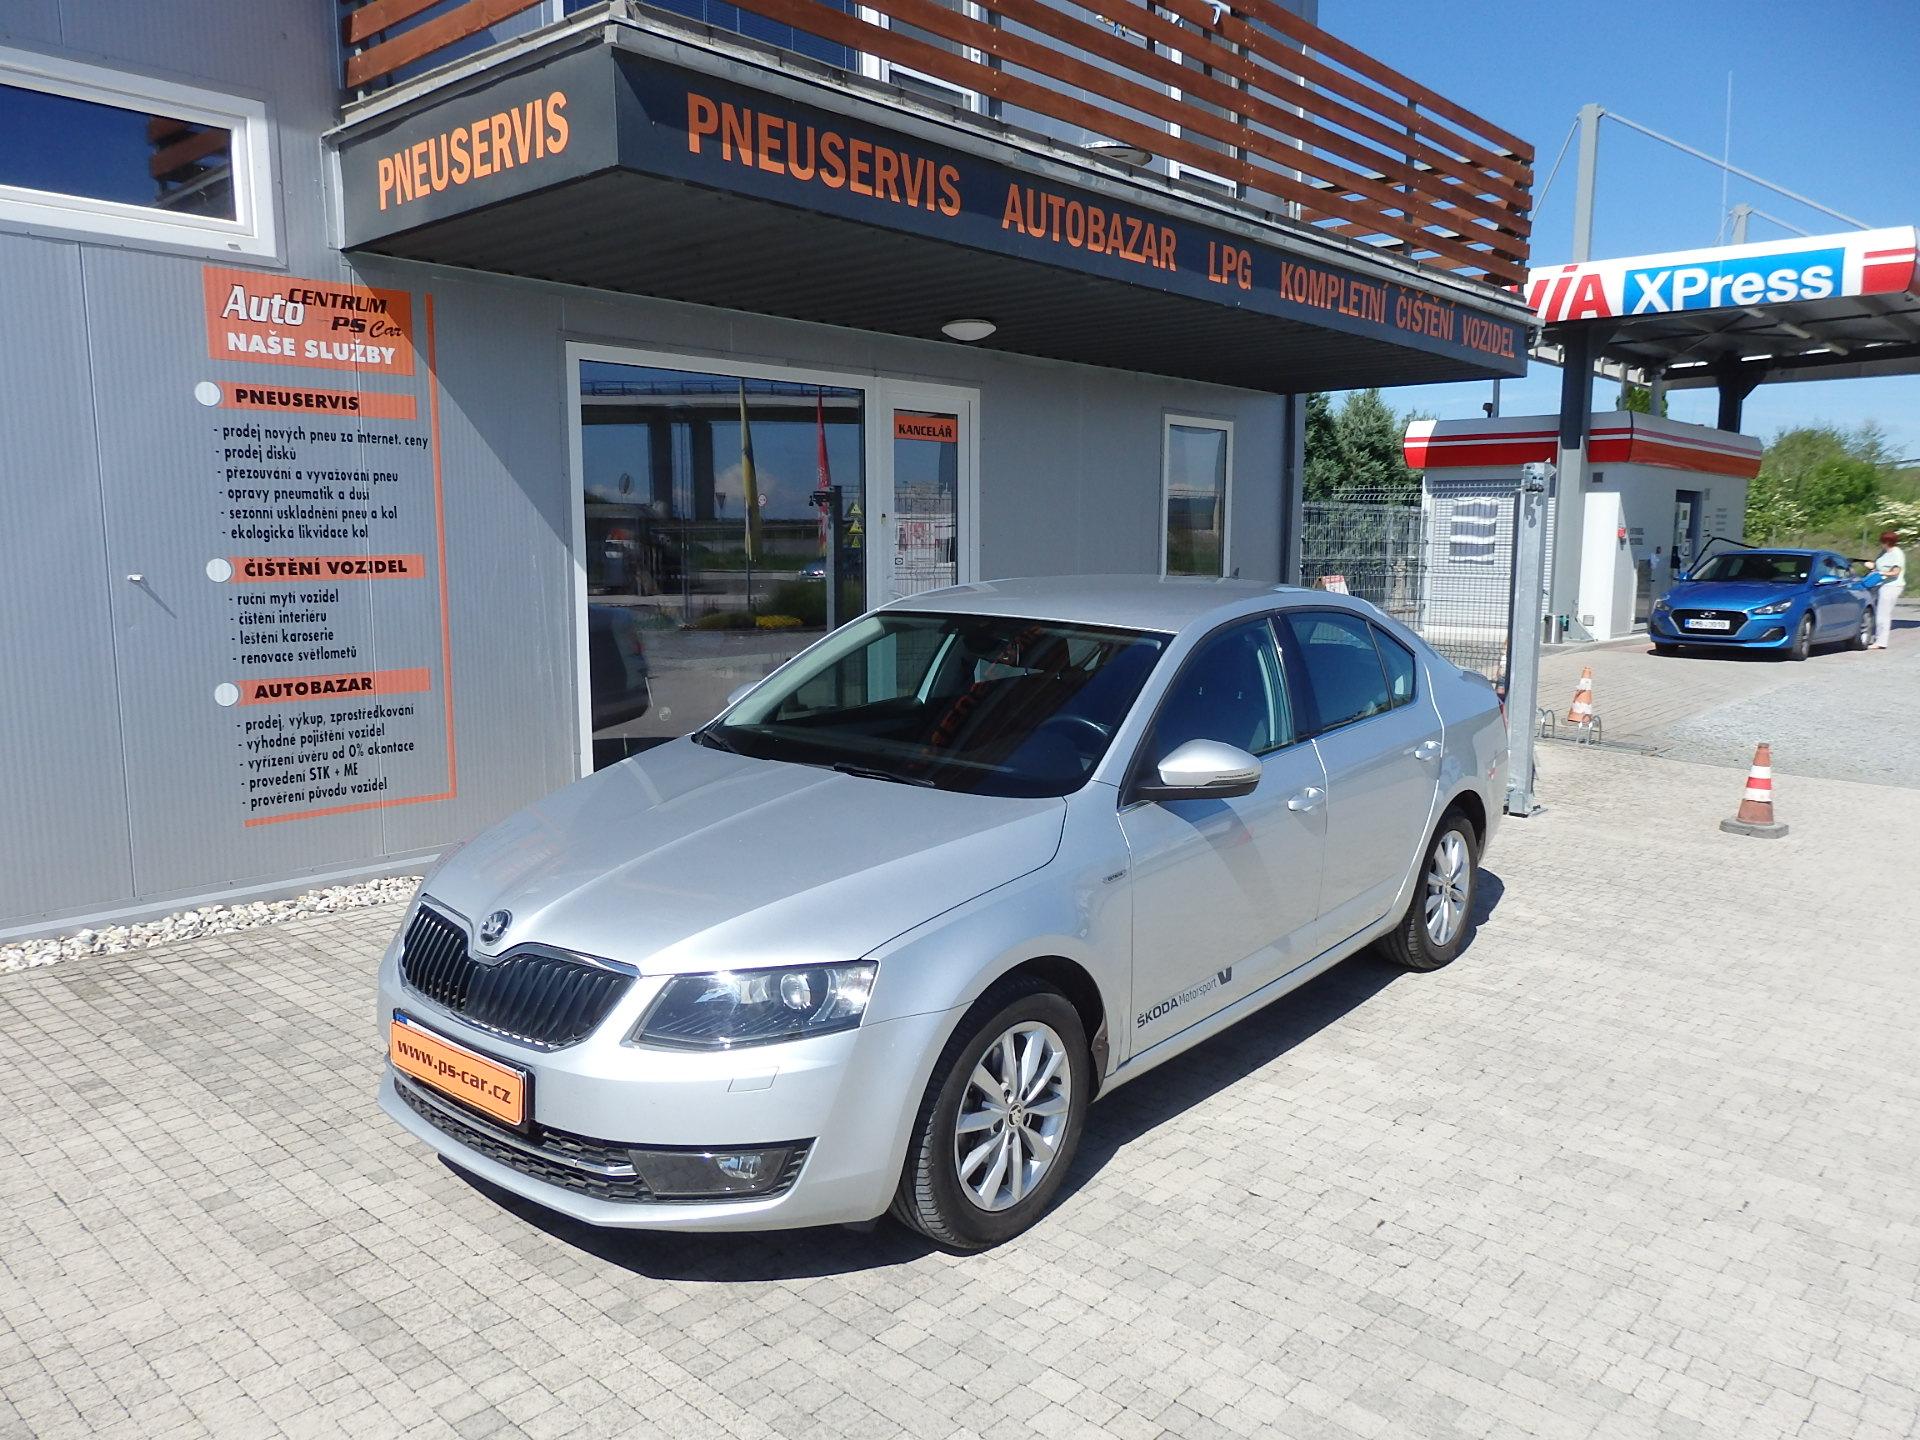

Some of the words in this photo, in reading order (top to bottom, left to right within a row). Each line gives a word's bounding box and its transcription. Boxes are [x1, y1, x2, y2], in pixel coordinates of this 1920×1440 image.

[378, 91, 569, 210] PNEUSERVIS
[687, 92, 961, 217] PNEUSERVIS
[1001, 183, 1177, 272] AUTOBAZAR
[1208, 241, 1252, 290] LPG
[1280, 261, 1389, 324] KOMPLETNÍ
[1396, 286, 1456, 341] ČIŠTĚNÍ
[1463, 314, 1515, 359] VOZIDEL
[1632, 263, 1834, 316] XPress
[221, 284, 305, 326] Auto
[288, 288, 388, 314] CENTRUM
[331, 317, 367, 333] PS
[369, 320, 403, 338] Car
[227, 330, 296, 357] NAŠE
[304, 338, 396, 365] SLUŽBY
[235, 388, 359, 411] PNEUSERVIS
[223, 423, 261, 442] prodej
[264, 426, 306, 443] nových
[310, 431, 337, 444] pneu
[341, 432, 353, 443] za
[357, 429, 402, 446] internet.
[404, 436, 429, 450] ceny
[898, 423, 953, 438] KANCELÁŘ
[225, 444, 263, 463] prodej
[266, 444, 297, 461] disků
[226, 466, 291, 483] přezouvání
[295, 470, 302, 480] a
[373, 471, 399, 485] pneu
[228, 488, 270, 504] opravy
[273, 485, 334, 503] pneumatik
[338, 490, 345, 500] a
[276, 504, 338, 520] uskladnění
[341, 509, 368, 523] pneu
[371, 510, 378, 519] a
[381, 505, 398, 519] kol
[231, 523, 294, 543] ekologická
[298, 523, 349, 539] likvidace
[352, 523, 368, 539] kol
[244, 558, 321, 577] ČIŠTĚNÍ
[327, 559, 408, 575] VOZIDEL
[237, 592, 266, 606] ruční
[300, 588, 339, 604] vozidel
[238, 610, 276, 626] čištění
[279, 609, 327, 624] interiéru
[240, 630, 278, 645] leštění
[282, 627, 334, 643] karoserie
[241, 652, 294, 665] renovace
[298, 645, 357, 662] světlometů
[254, 677, 373, 699] AUTOBAZAR
[289, 711, 326, 730] výkup,
[330, 703, 414, 726] zprostředkování
[247, 732, 296, 754] výhodné
[300, 728, 345, 748] pojištění
[348, 722, 386, 739] vozidel
[248, 753, 295, 773] vyřízení
[332, 744, 345, 760] od
[348, 742, 365, 758] 0%
[367, 741, 415, 756] akontace
[249, 769, 306, 793] provedení
[309, 765, 331, 781] STK
[344, 762, 359, 777] ME
[250, 788, 305, 812] prověření
[308, 782, 347, 803] původu
[350, 776, 388, 794] vozidel
[1137, 998, 1179, 1029] ŠKODA
[1178, 979, 1217, 1006] Motorsport
[397, 1040, 512, 1105] www.ps-car.cz
